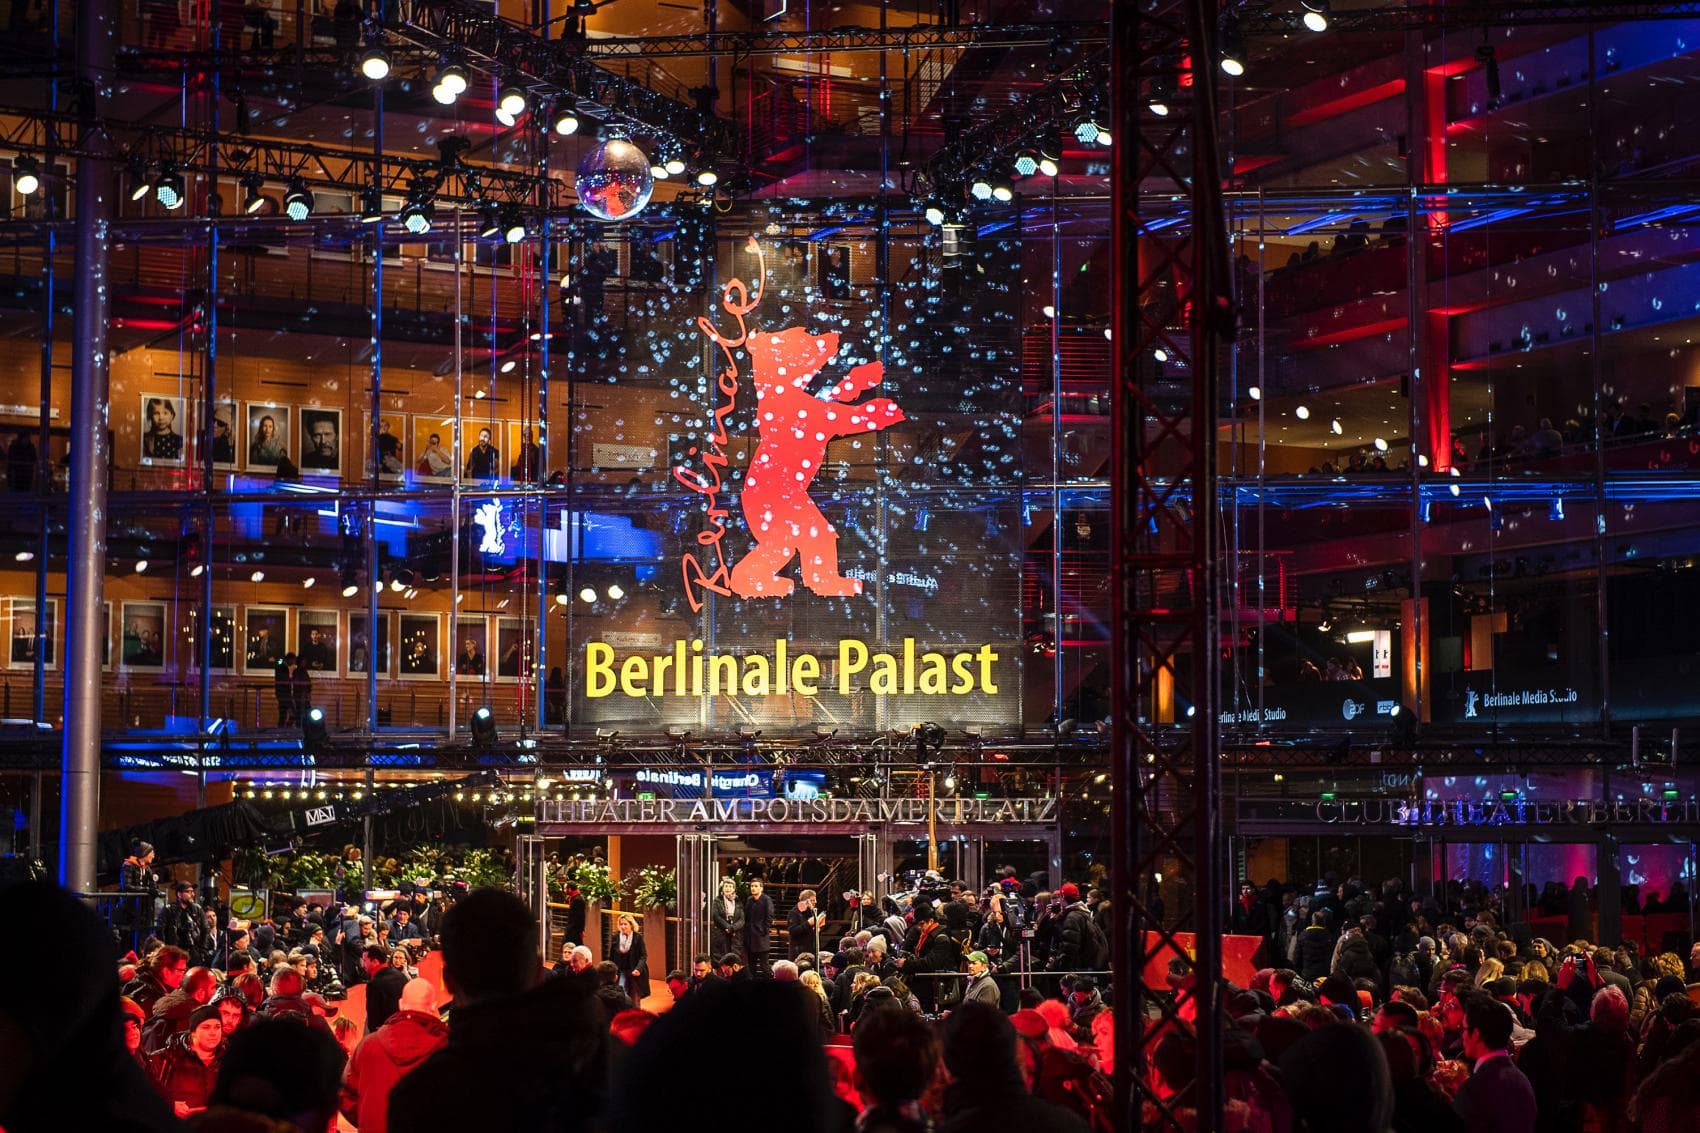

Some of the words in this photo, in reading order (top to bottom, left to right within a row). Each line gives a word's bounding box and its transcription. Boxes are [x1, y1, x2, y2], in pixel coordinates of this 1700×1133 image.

[674, 238, 765, 612] Berlinale
[586, 638, 820, 698] Berlinale
[837, 637, 999, 696] Palast
[1484, 692, 1521, 708] Berlinale
[1522, 690, 1548, 705] Media
[1242, 708, 1261, 722] Medi
[1263, 707, 1287, 720] Studio
[306, 806, 335, 824] MAT
[540, 798, 677, 823] THEATER
[688, 798, 740, 823] AM
[750, 798, 950, 824] POTSDAMER
[957, 798, 1058, 825] PLATZ
[1315, 799, 1406, 825] CLUB
